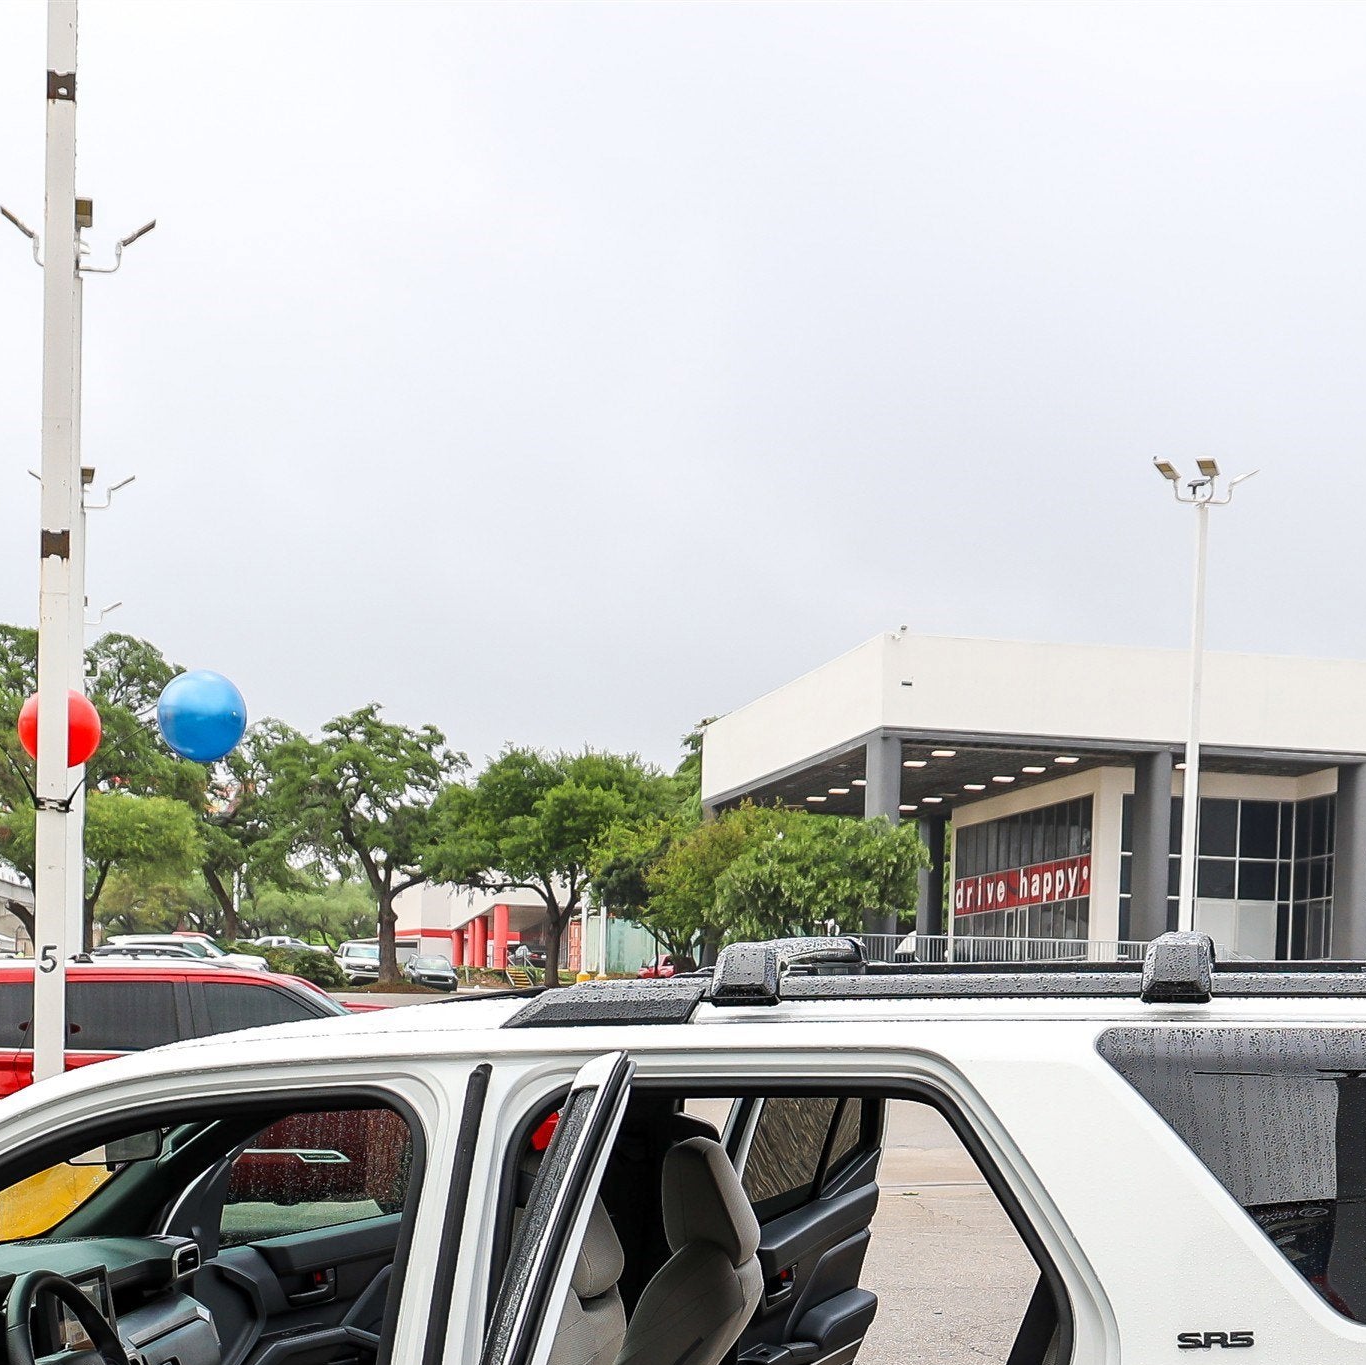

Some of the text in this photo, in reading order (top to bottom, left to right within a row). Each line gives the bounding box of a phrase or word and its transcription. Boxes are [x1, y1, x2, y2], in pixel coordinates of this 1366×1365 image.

[955, 868, 1078, 909] drive happy
[39, 945, 57, 973] 5
[1177, 1331, 1254, 1349] SR5
